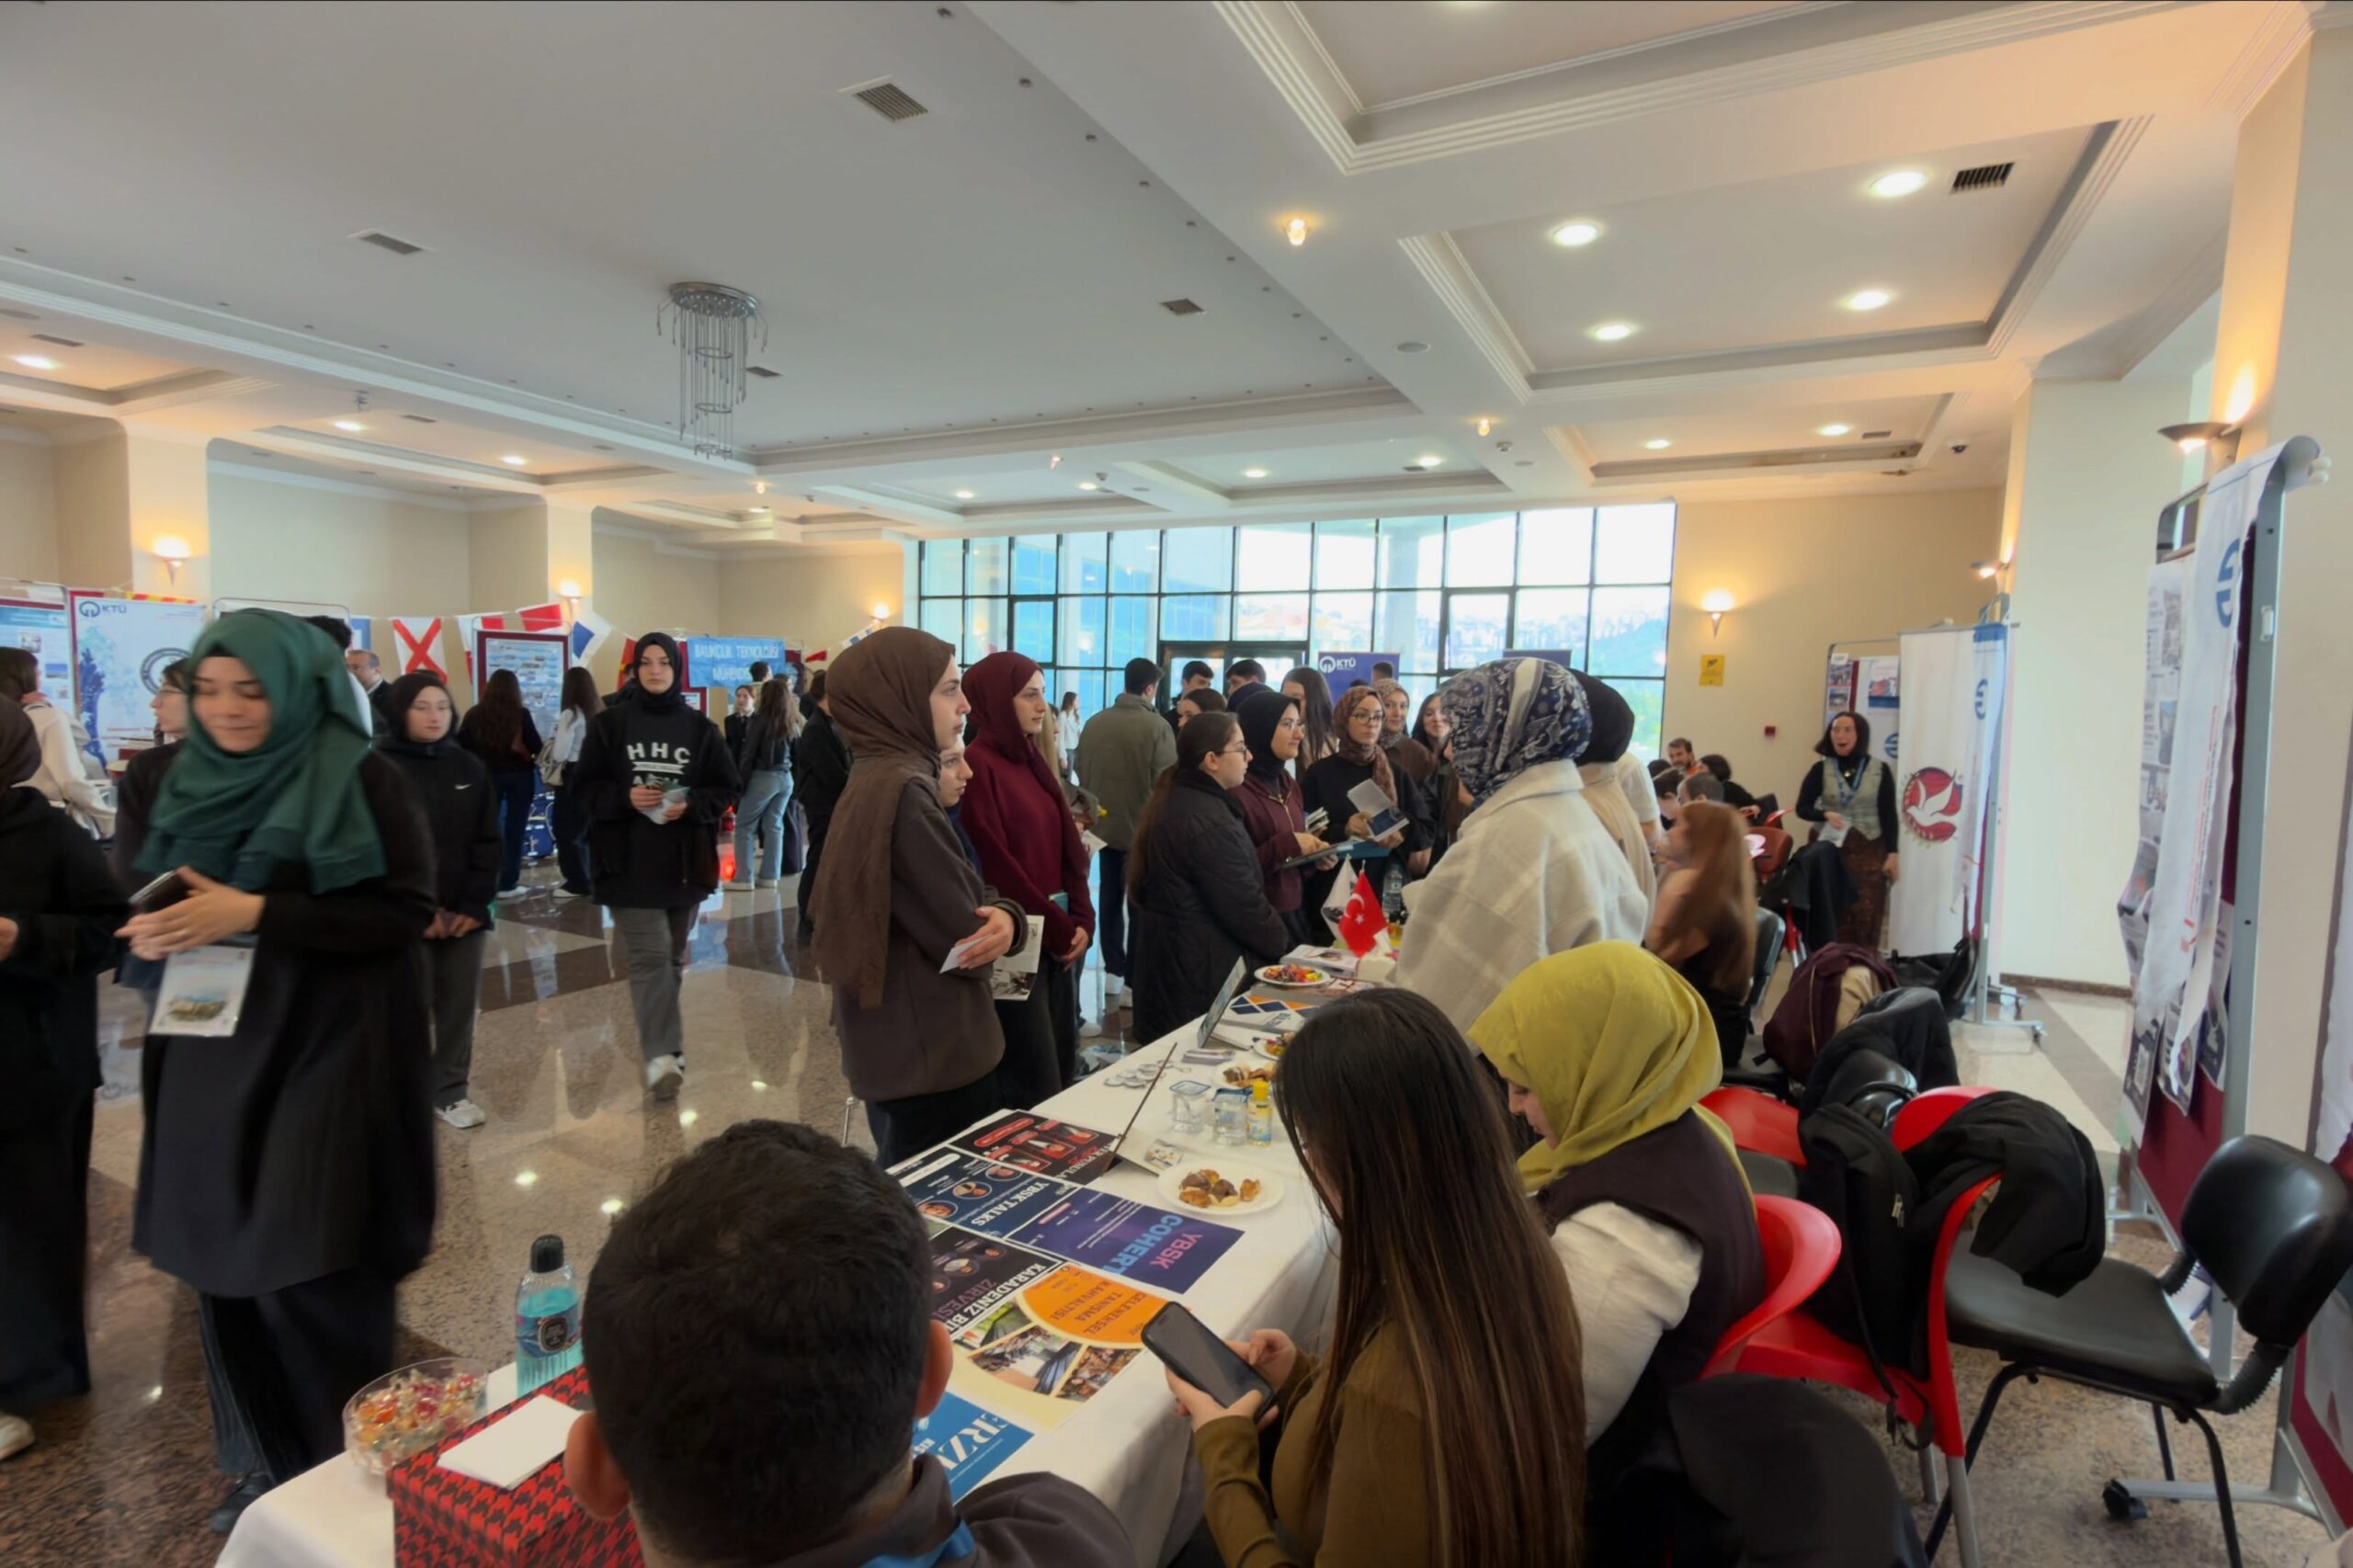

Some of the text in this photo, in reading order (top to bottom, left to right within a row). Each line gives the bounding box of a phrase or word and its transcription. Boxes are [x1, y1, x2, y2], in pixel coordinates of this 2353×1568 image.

[102, 604, 127, 614] KTÜ
[1336, 657, 1357, 668] KTÜ
[1010, 1182, 1050, 1203] YBSK
[971, 1200, 1019, 1226] TALKS
[1102, 1214, 1184, 1275] COHERT
[1150, 1233, 1203, 1269] YBSK
[963, 1263, 1046, 1316] KARADENİZ
[1083, 1291, 1147, 1334] GELENEKSEL
